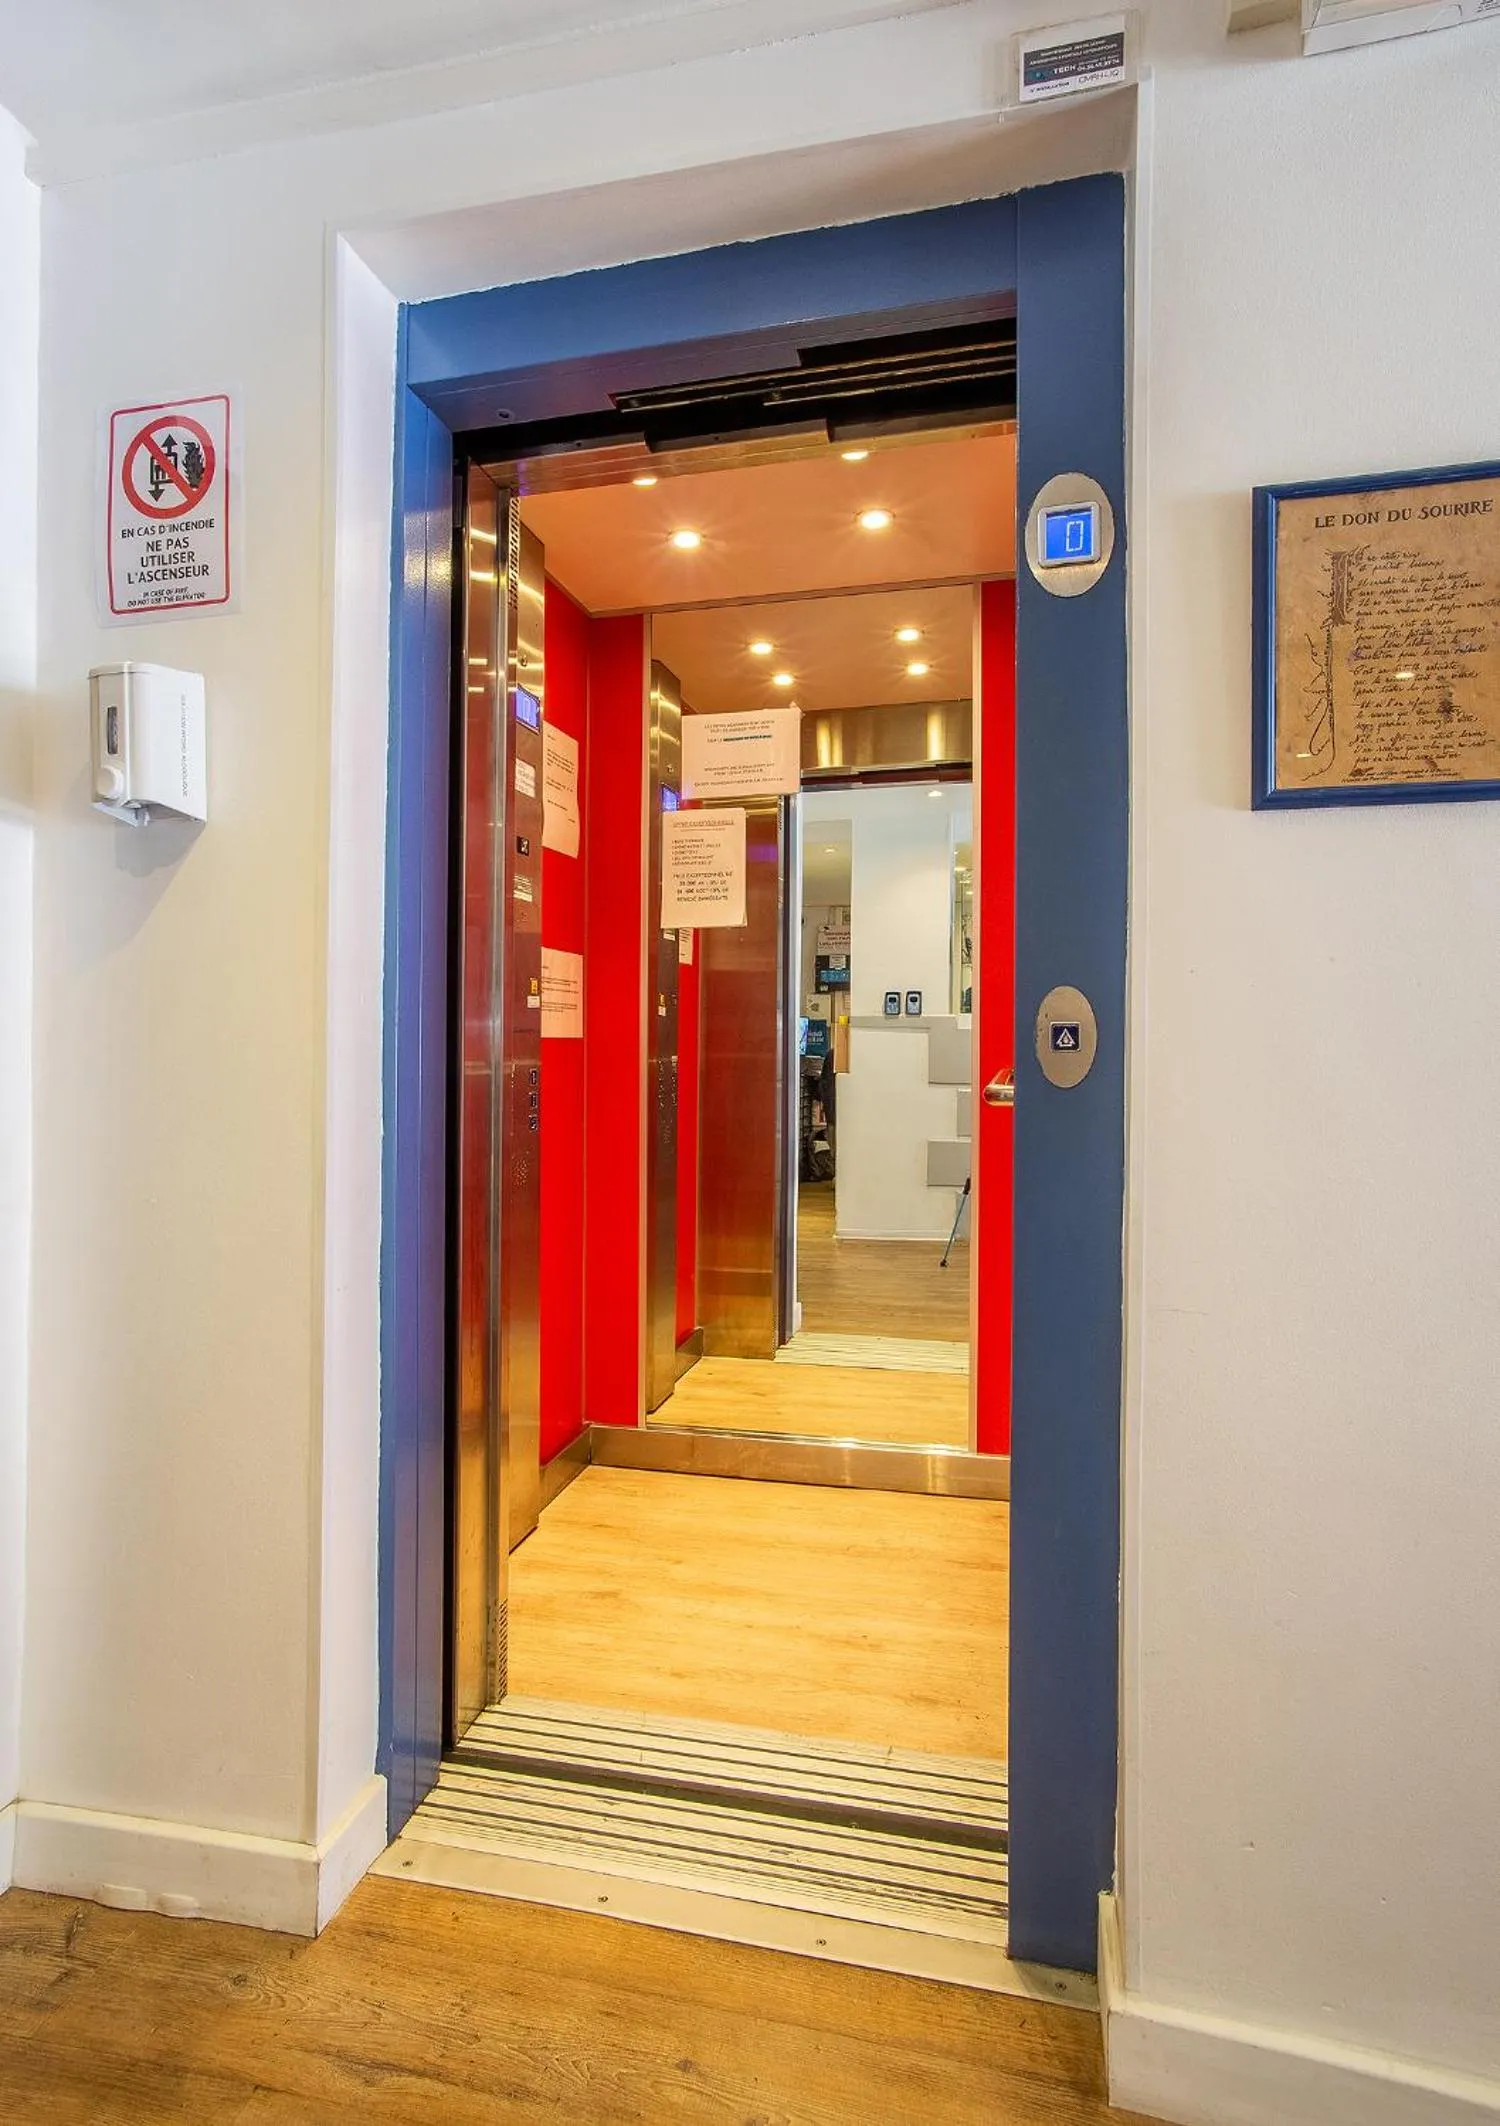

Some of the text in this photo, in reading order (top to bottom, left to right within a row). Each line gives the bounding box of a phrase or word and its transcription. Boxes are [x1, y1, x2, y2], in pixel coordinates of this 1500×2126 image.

[1315, 499, 1494, 528] LE DON DU SOURIRE
[121, 518, 215, 539] EN CAS D'INCENDIE
[1065, 520, 1084, 552] 0
[146, 536, 190, 552] NE PAS
[140, 551, 195, 568] UTILISER
[127, 564, 210, 584] L'ASCENSEUR
